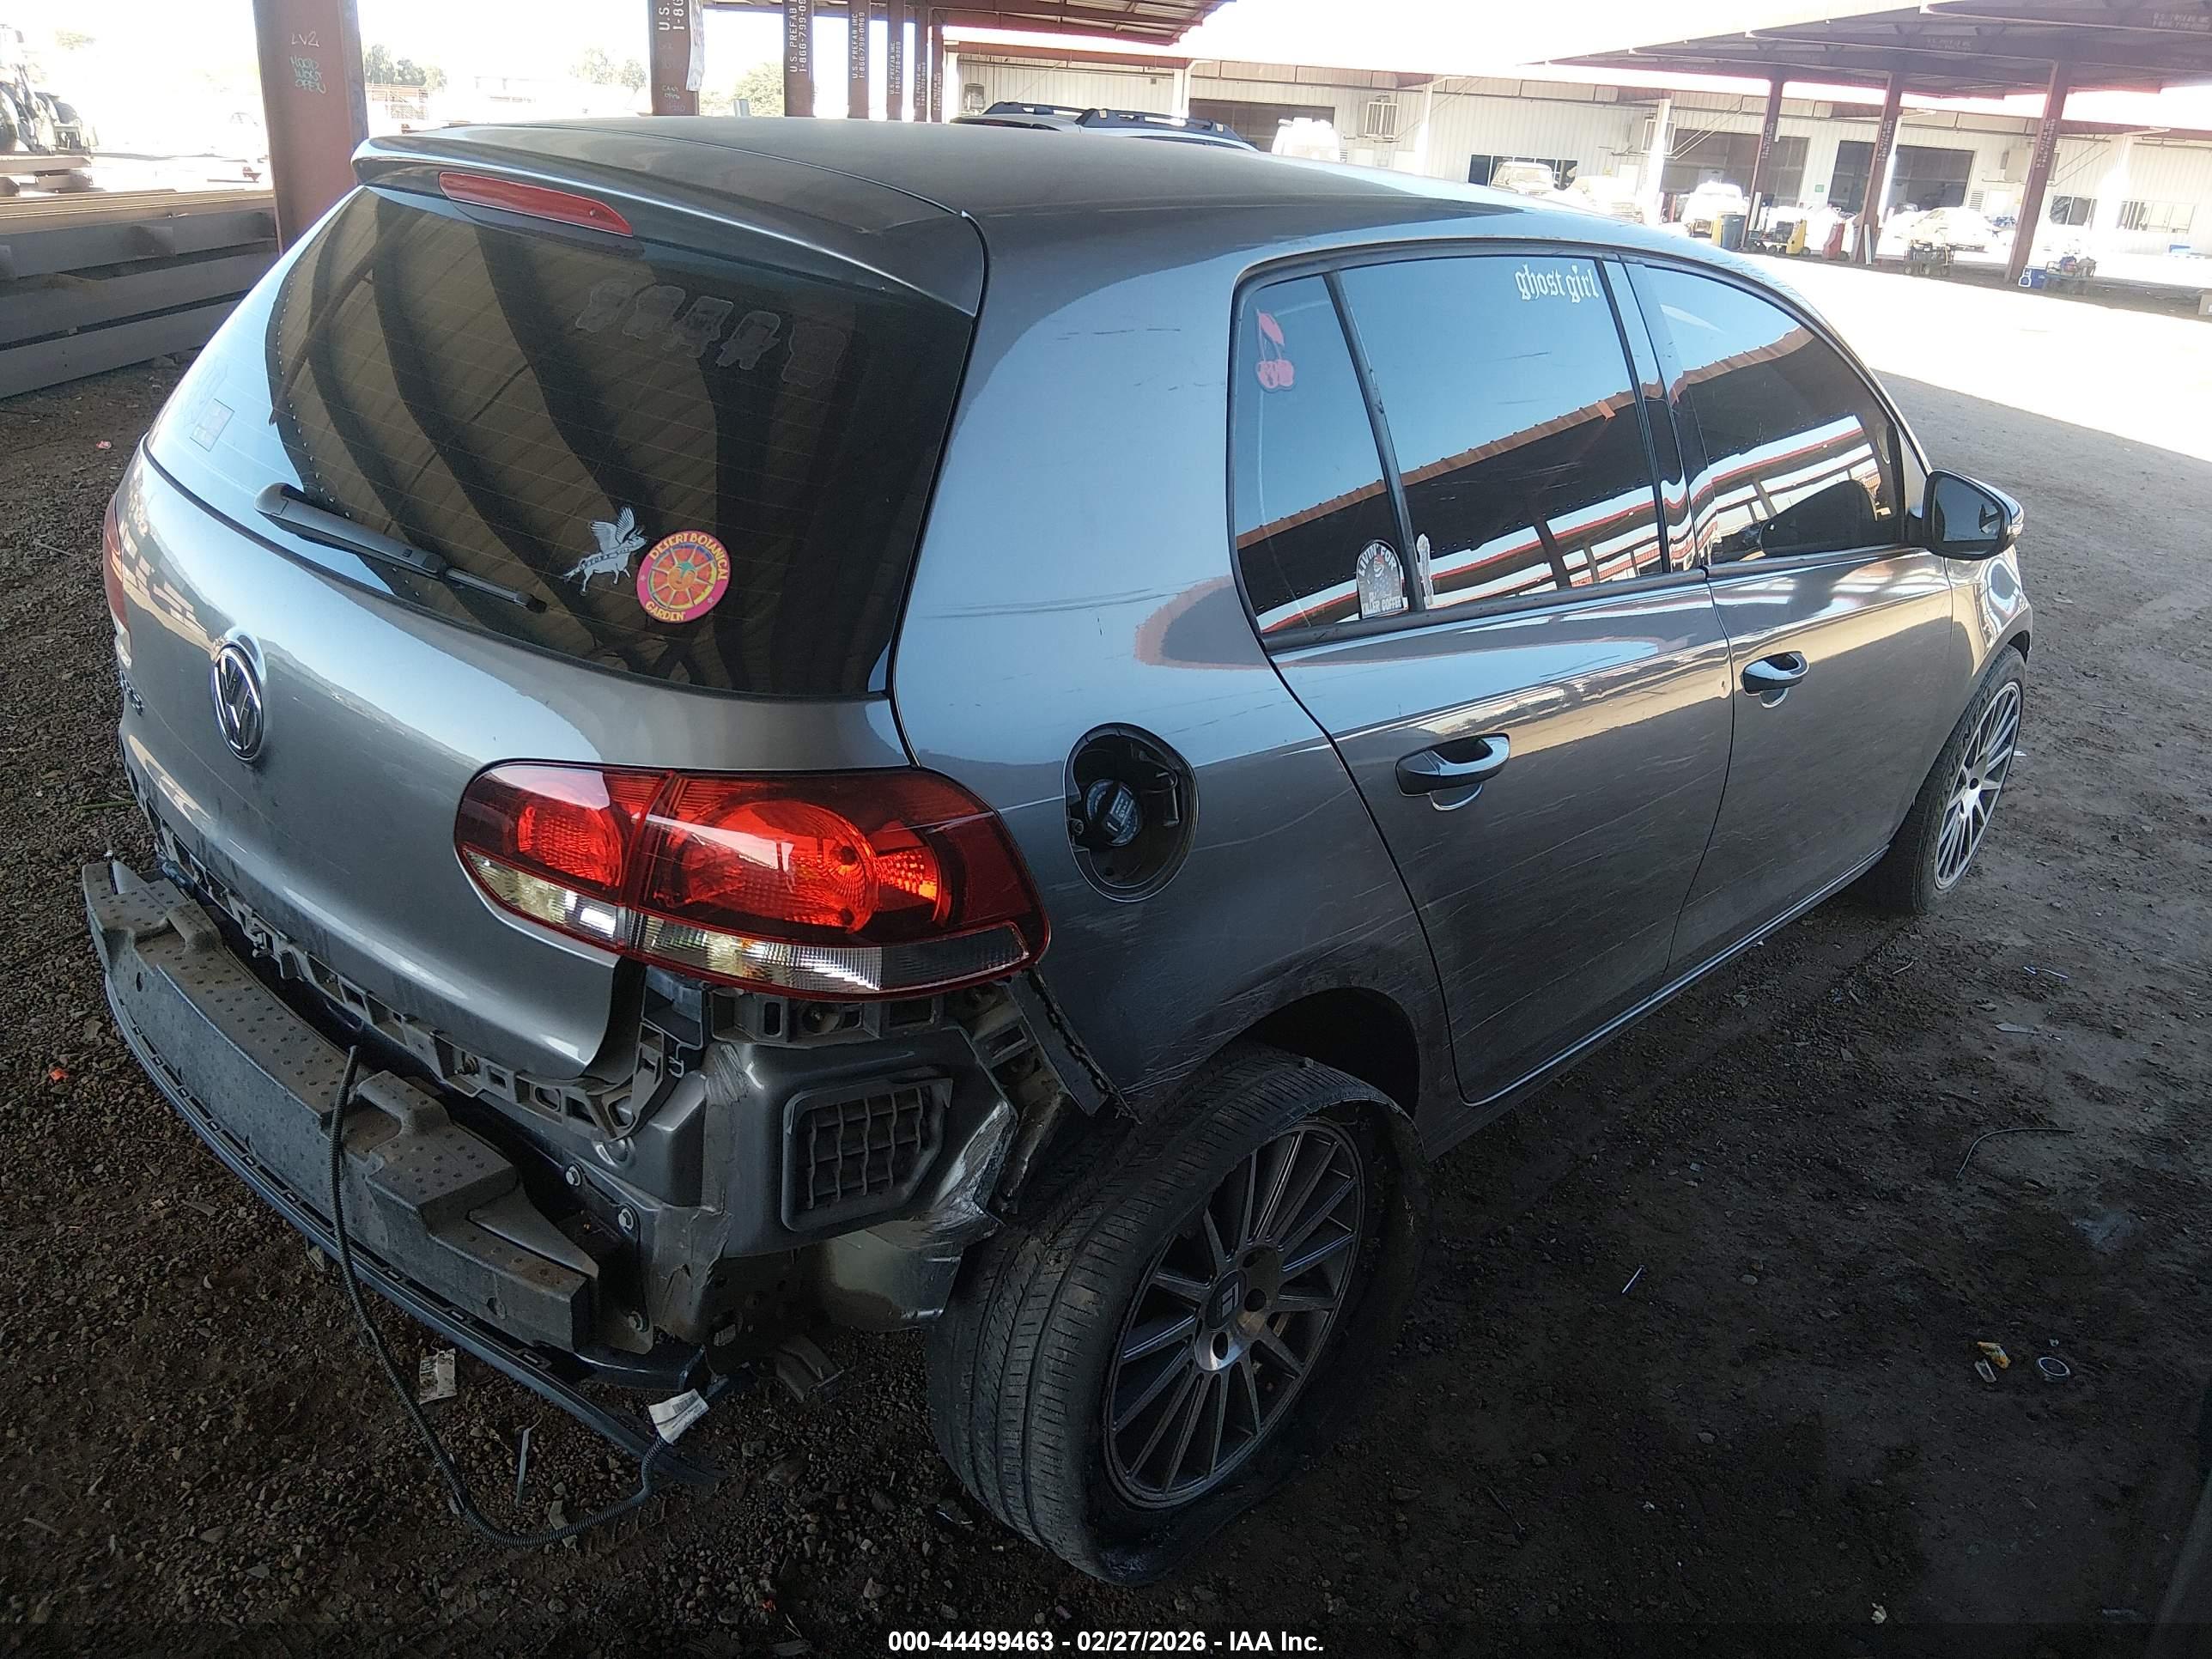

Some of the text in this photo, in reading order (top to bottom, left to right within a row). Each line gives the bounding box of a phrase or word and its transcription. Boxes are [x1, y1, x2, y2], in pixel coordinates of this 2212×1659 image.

[789, 8, 798, 47] PREFAB
[789, 53, 798, 73] U.S.
[1515, 263, 1600, 303] ghost girl
[649, 532, 690, 560] DESERT
[690, 532, 729, 580] BOTANICAL
[1380, 546, 1397, 570] FOR
[645, 601, 685, 622] GARDEN
